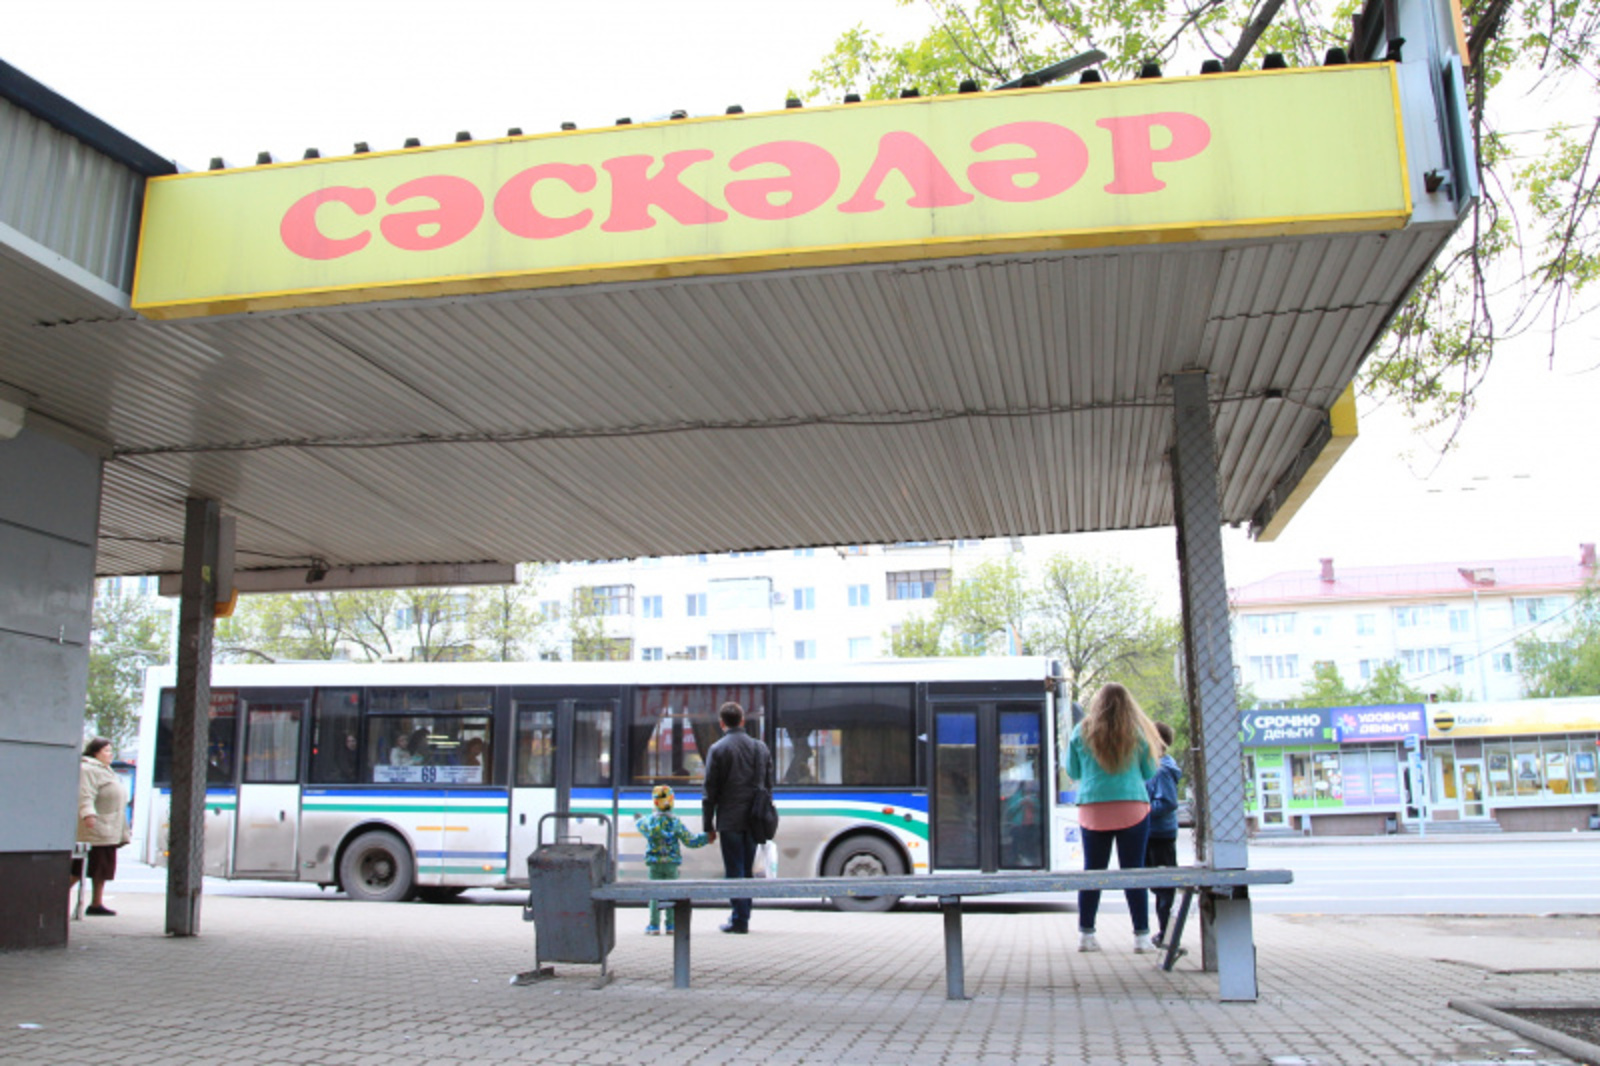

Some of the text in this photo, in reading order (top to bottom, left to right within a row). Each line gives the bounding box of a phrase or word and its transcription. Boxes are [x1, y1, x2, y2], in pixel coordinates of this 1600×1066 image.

[1253, 713, 1321, 729] СРОЧНО
[1357, 711, 1421, 723] УДОБНЫЕ
[1359, 722, 1411, 734] ДЕНЬГИ
[421, 765, 437, 783] 69
